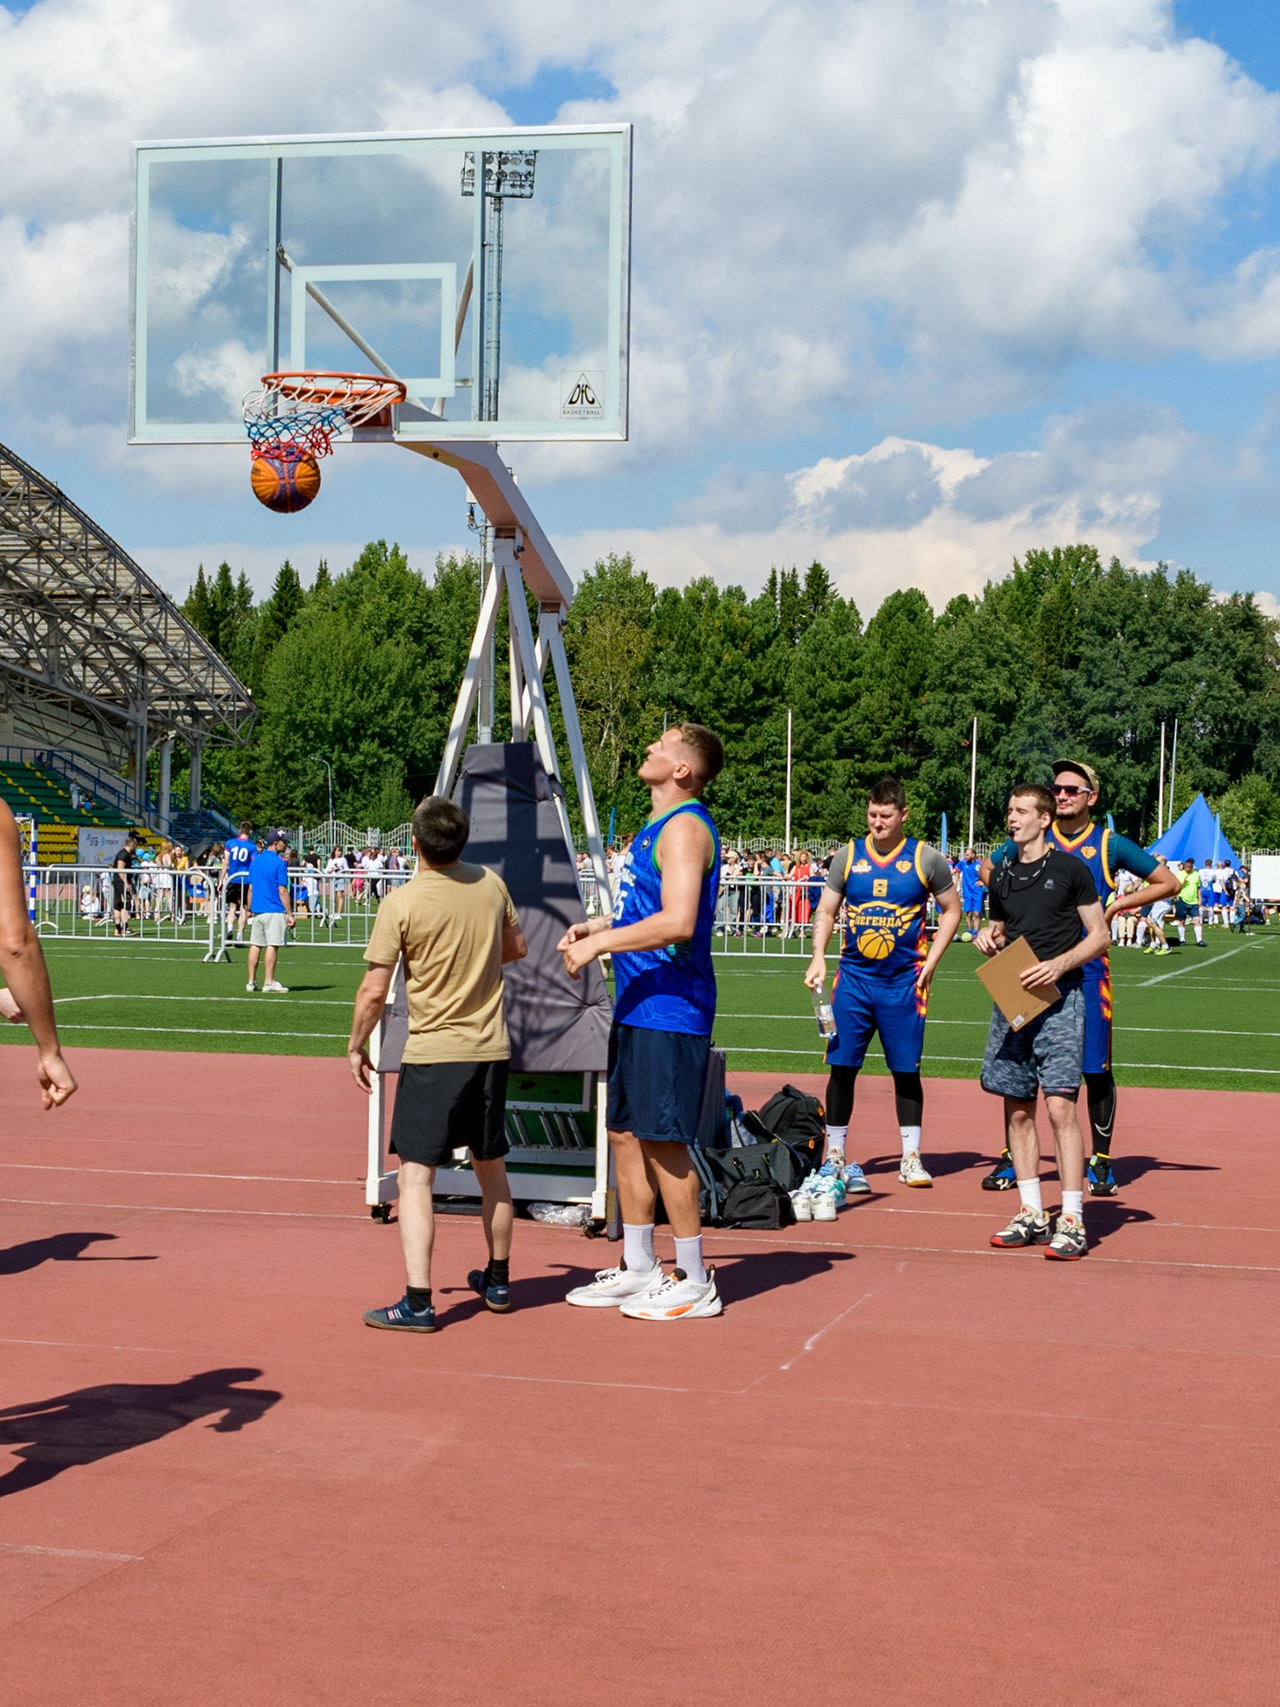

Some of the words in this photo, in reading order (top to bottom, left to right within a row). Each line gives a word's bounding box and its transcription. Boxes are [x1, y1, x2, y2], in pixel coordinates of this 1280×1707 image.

[231, 846, 248, 862] 10
[873, 879, 888, 897] 8
[854, 915, 902, 928] ЛЕГЕНДА
